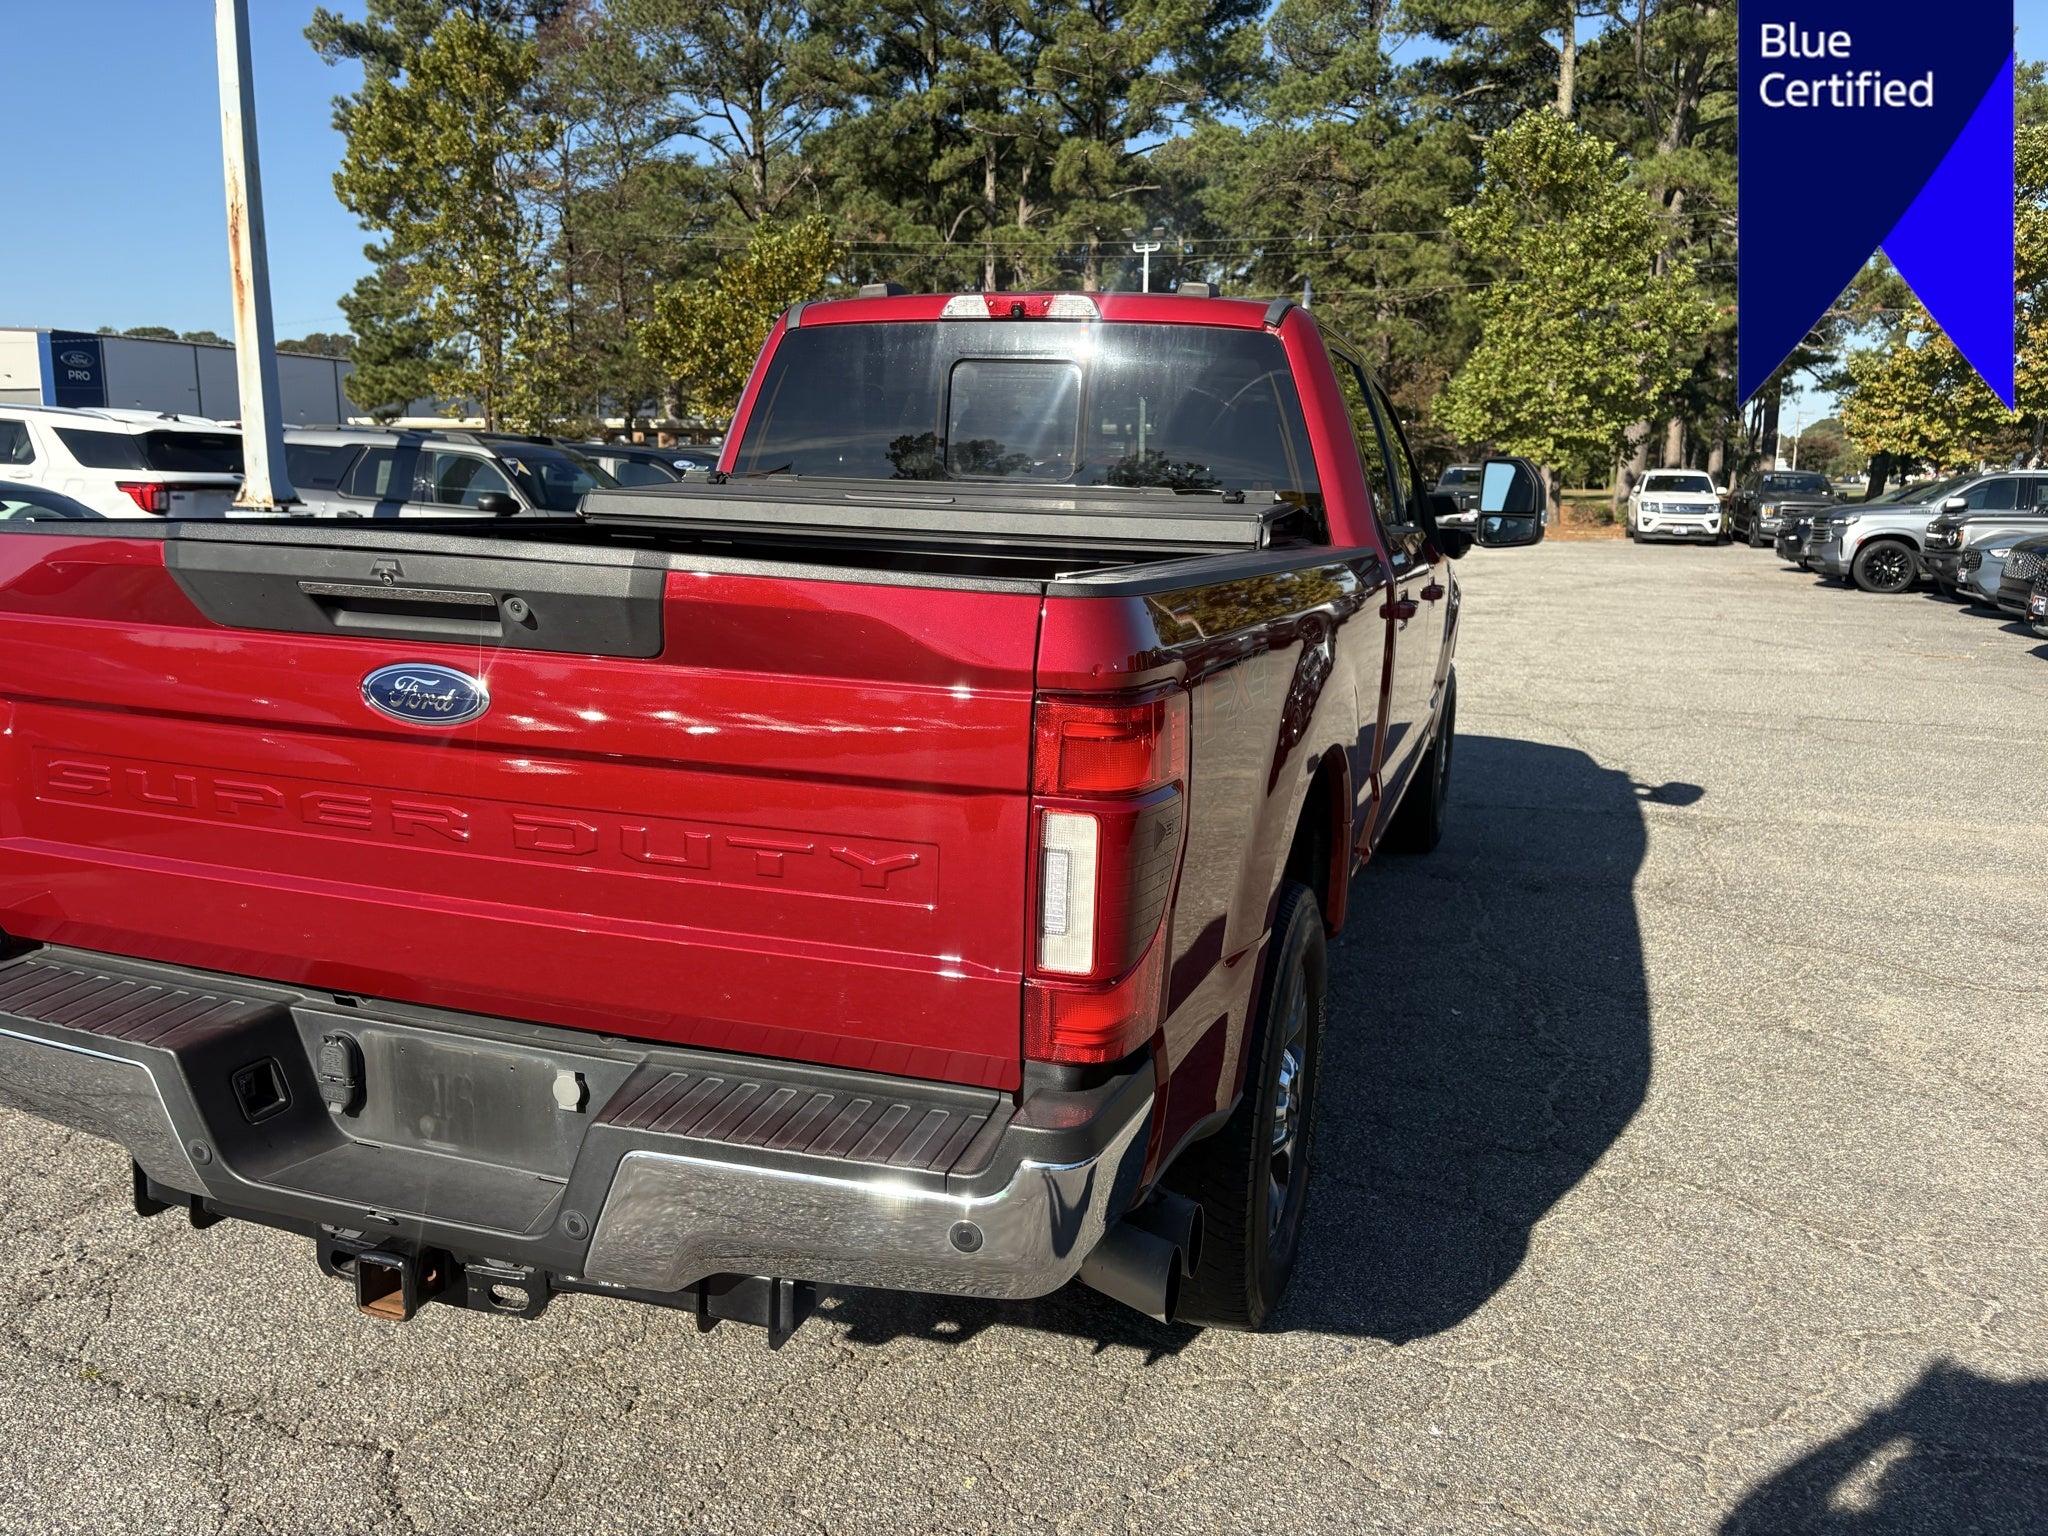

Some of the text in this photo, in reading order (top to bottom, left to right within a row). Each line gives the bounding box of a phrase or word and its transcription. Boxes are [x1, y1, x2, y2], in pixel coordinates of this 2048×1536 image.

[68, 370, 91, 381] PRO
[388, 675, 456, 713] Ford
[47, 759, 921, 890] SUPER DUTY
